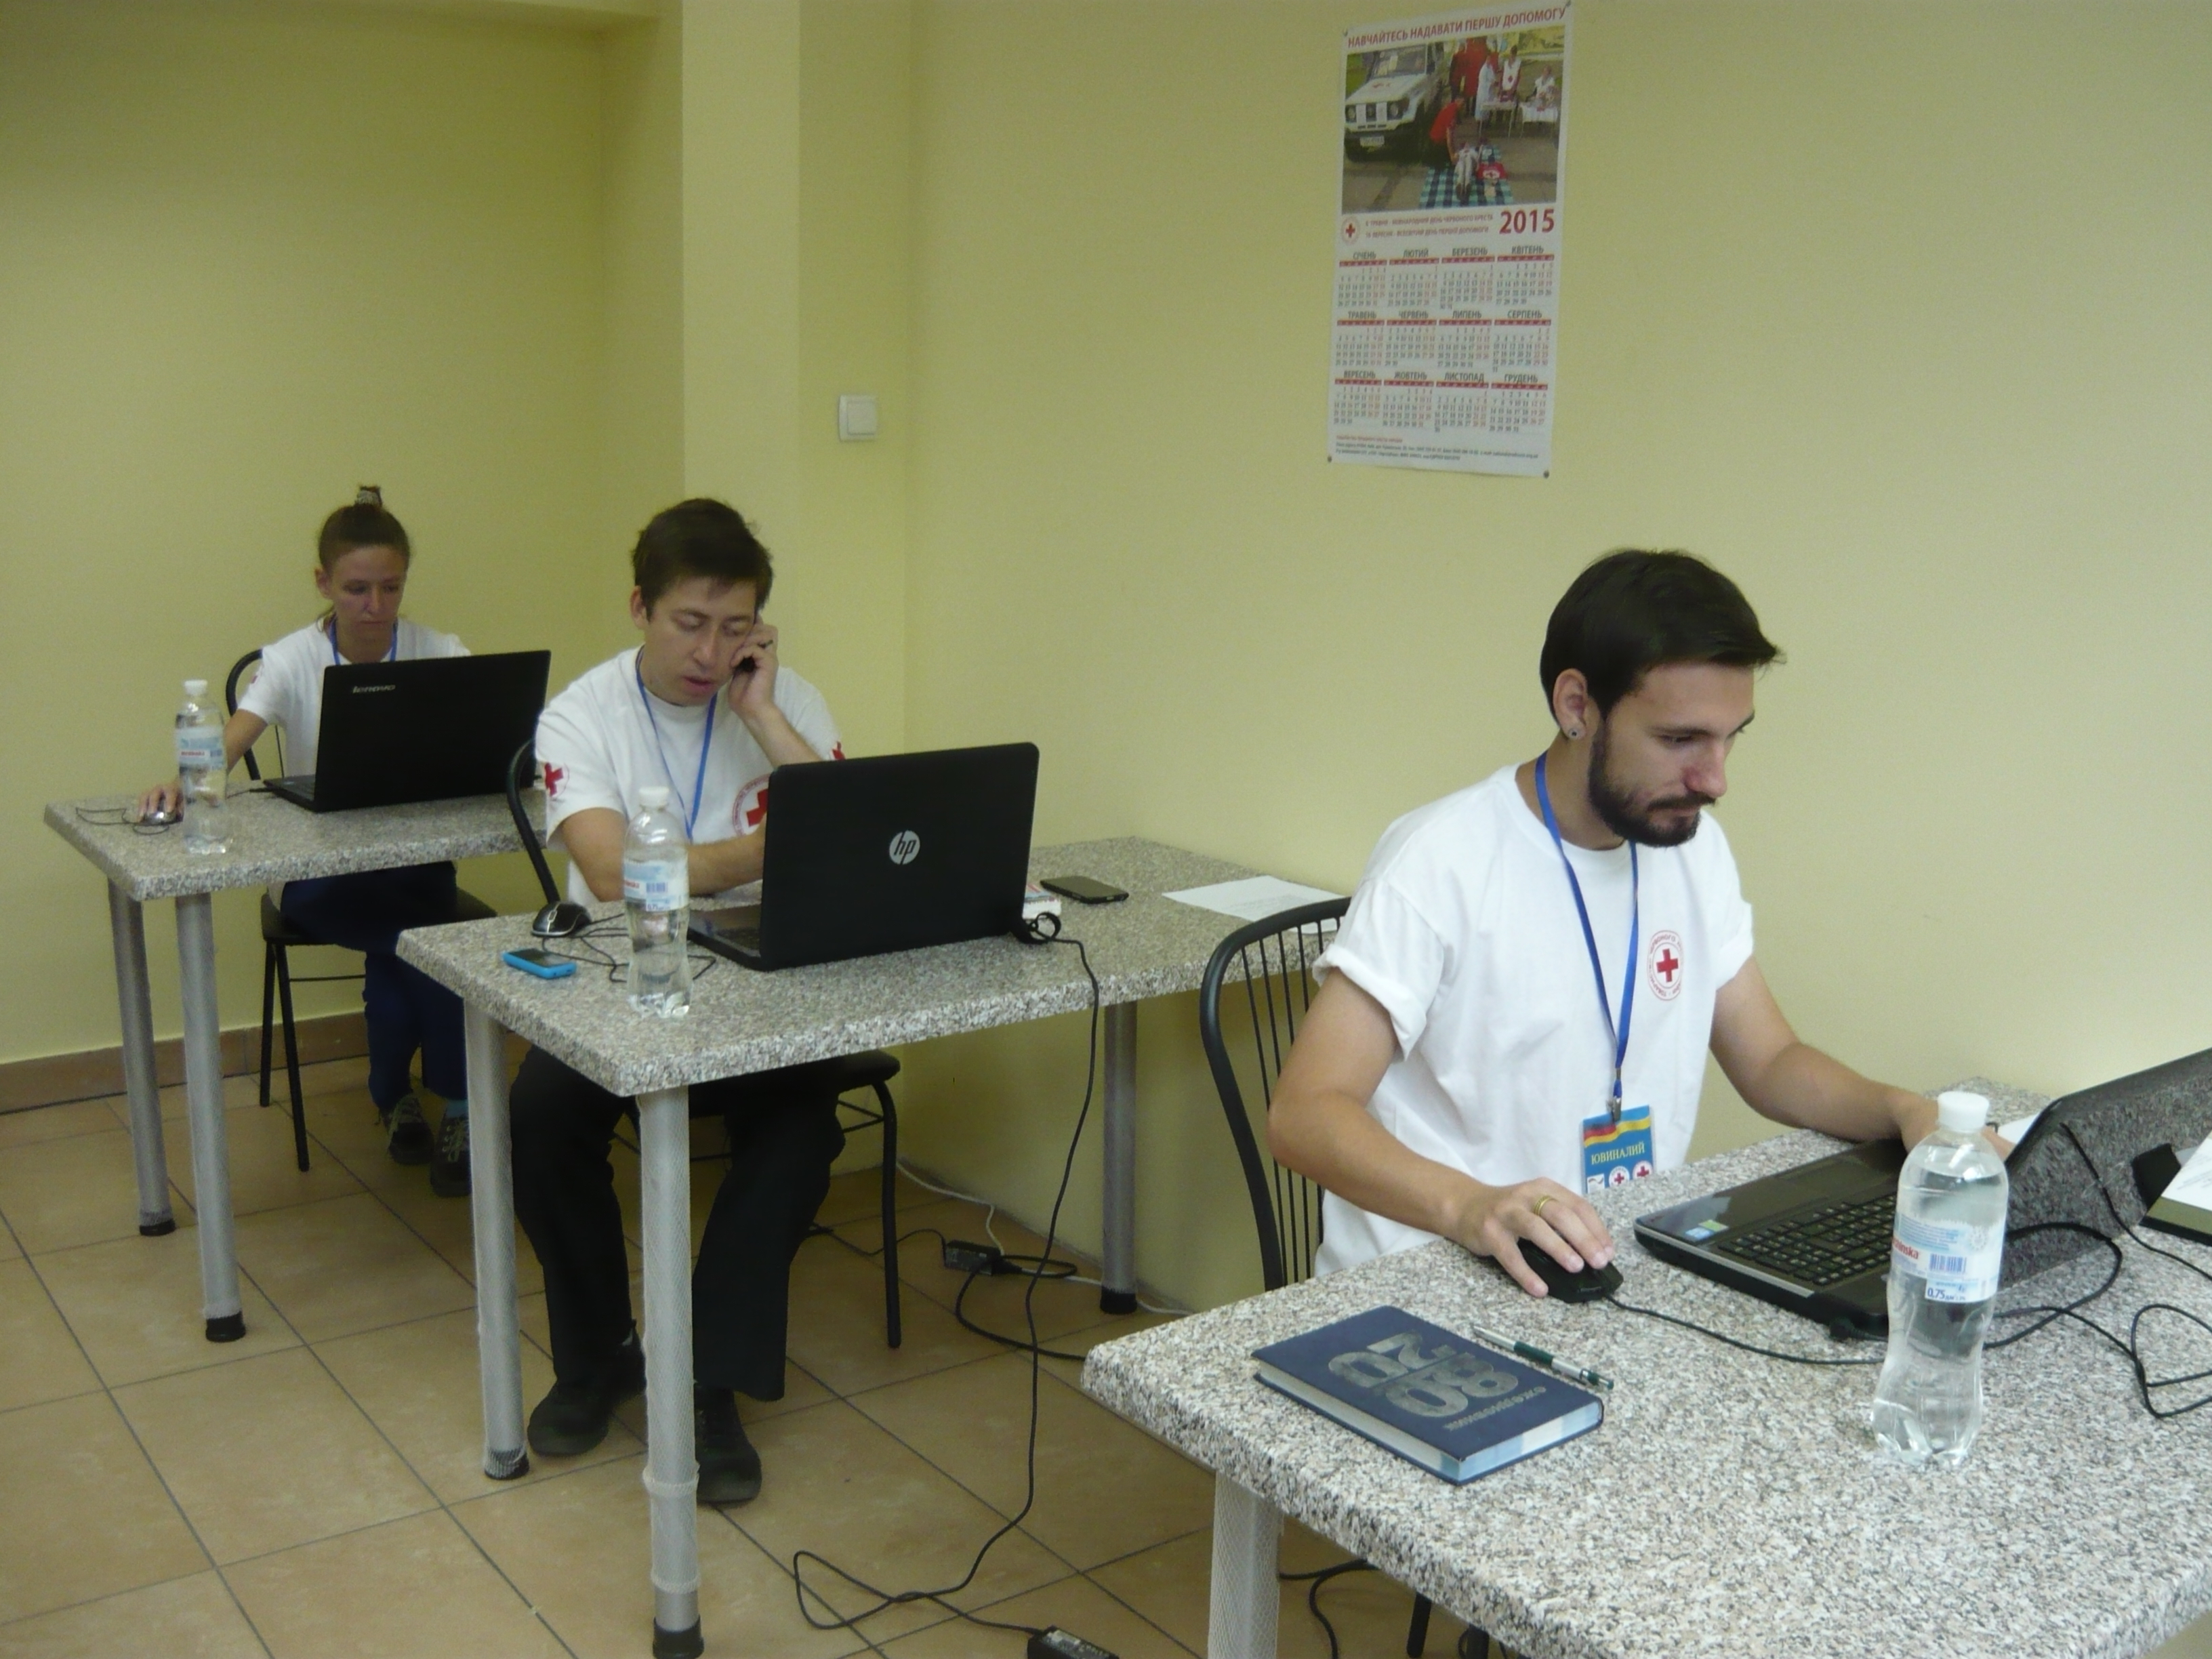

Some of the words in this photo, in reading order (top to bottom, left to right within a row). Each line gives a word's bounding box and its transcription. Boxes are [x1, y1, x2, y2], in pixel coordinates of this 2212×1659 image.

[1348, 28, 1408, 48] НАВЧАЙТЕСЬ
[1410, 20, 1462, 39] НАДАВАТИ
[1465, 15, 1502, 31] ПЕРШУ
[1502, 6, 1566, 28] ДОПОМОГУ
[1499, 208, 1555, 234] 2015
[1404, 248, 1429, 258] ЛЮТИЙ
[1452, 247, 1488, 256] БЕРЕЗЕНЬ
[1511, 245, 1544, 254] КВІТЕНЬ
[1348, 310, 1377, 319] ТРАВЕНЬ
[1399, 310, 1429, 319] ЧЕРВЕНЬ
[1452, 310, 1482, 319] ЛИПЕНЬ
[1507, 310, 1542, 319] СЕРПЕНЬ
[1344, 371, 1376, 379] ВЕРЕСЕНЬ
[1394, 371, 1427, 380] ЖОВТЕНЬ
[1444, 373, 1484, 384] ЛИСТОПАД
[1504, 373, 1538, 384] ГРУДЕНЬ
[891, 830, 919, 865] hp
[1591, 1141, 1645, 1165] ЮВИНАЛИЙ
[1328, 1331, 1456, 1389] 20
[1385, 1353, 1519, 1418] 80
